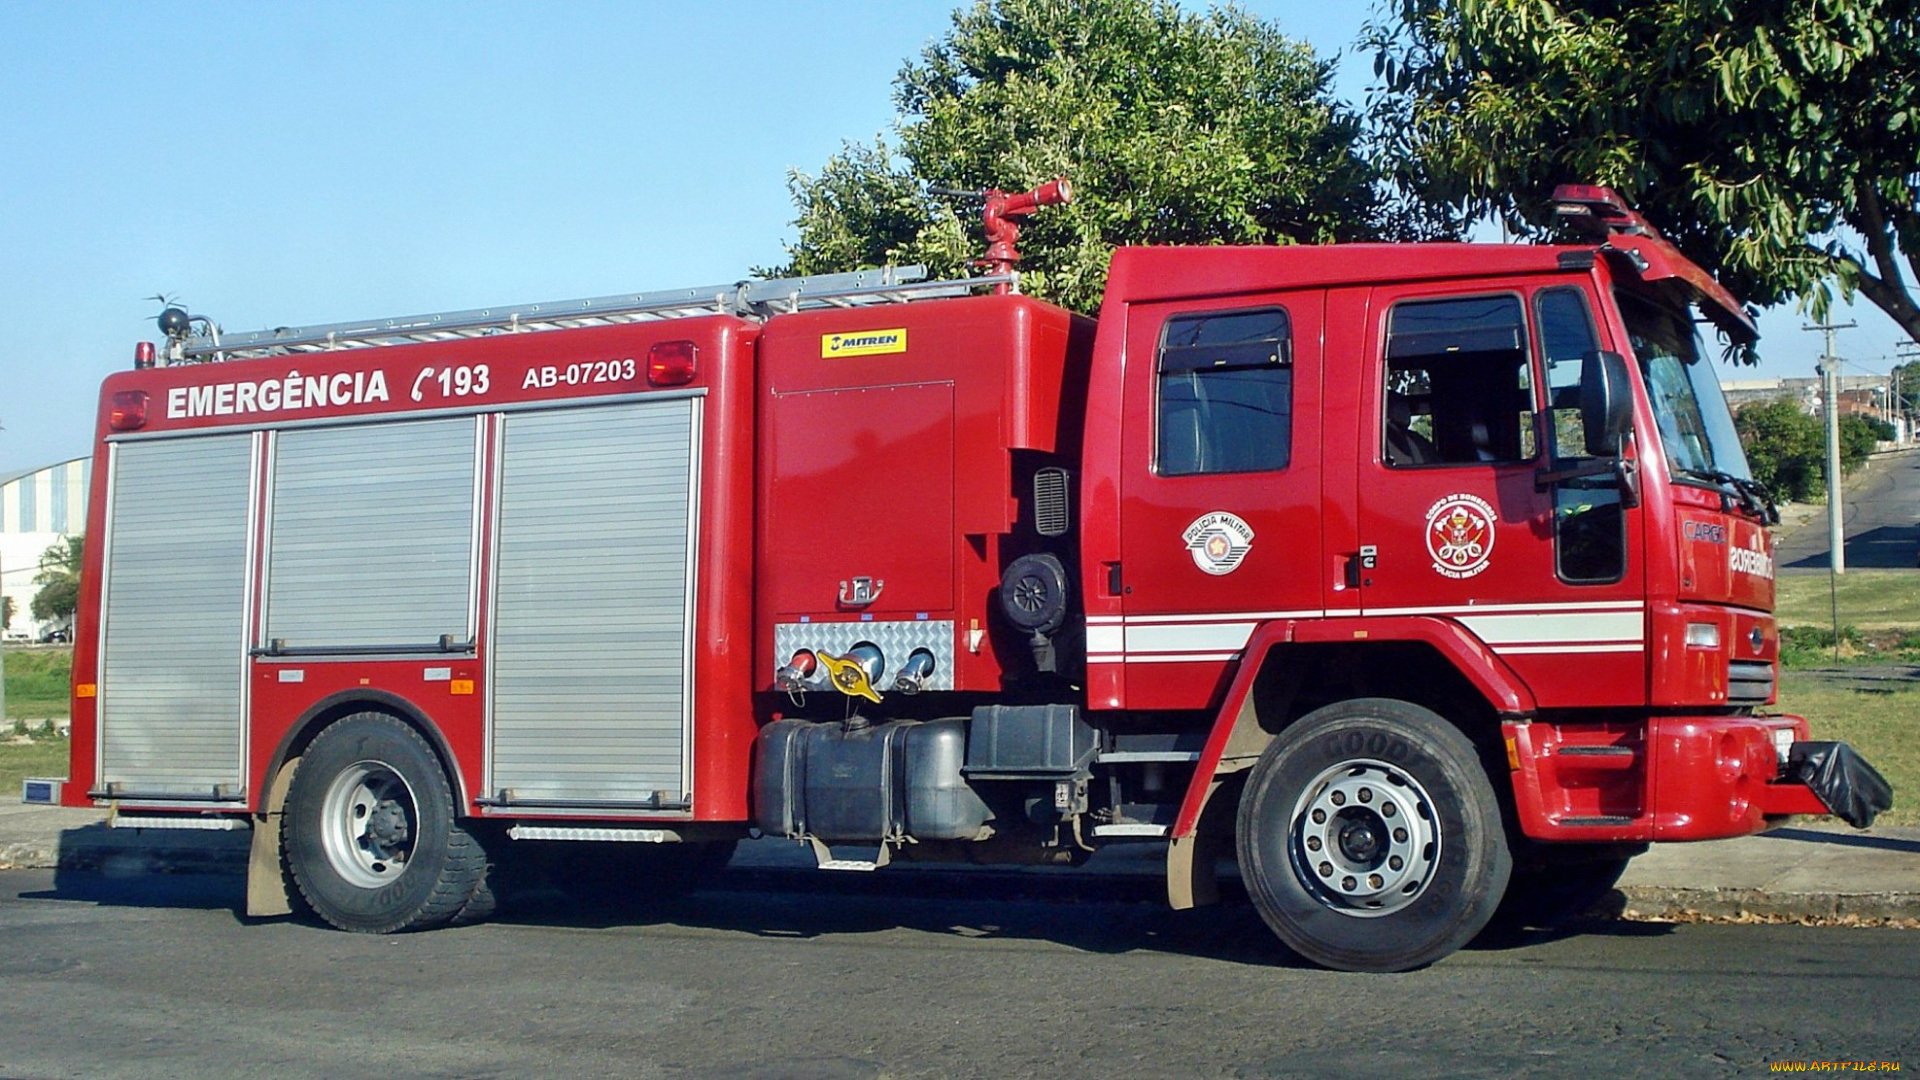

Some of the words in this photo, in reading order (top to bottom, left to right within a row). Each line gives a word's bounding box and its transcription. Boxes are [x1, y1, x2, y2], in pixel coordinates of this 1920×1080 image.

[842, 335, 897, 347] MITREN
[521, 359, 636, 389] AB-07203
[167, 370, 389, 419] EMERGÊNCIA
[437, 364, 490, 397] 193
[1187, 515, 1217, 540] POLICIA
[1220, 515, 1250, 540] MILITAR
